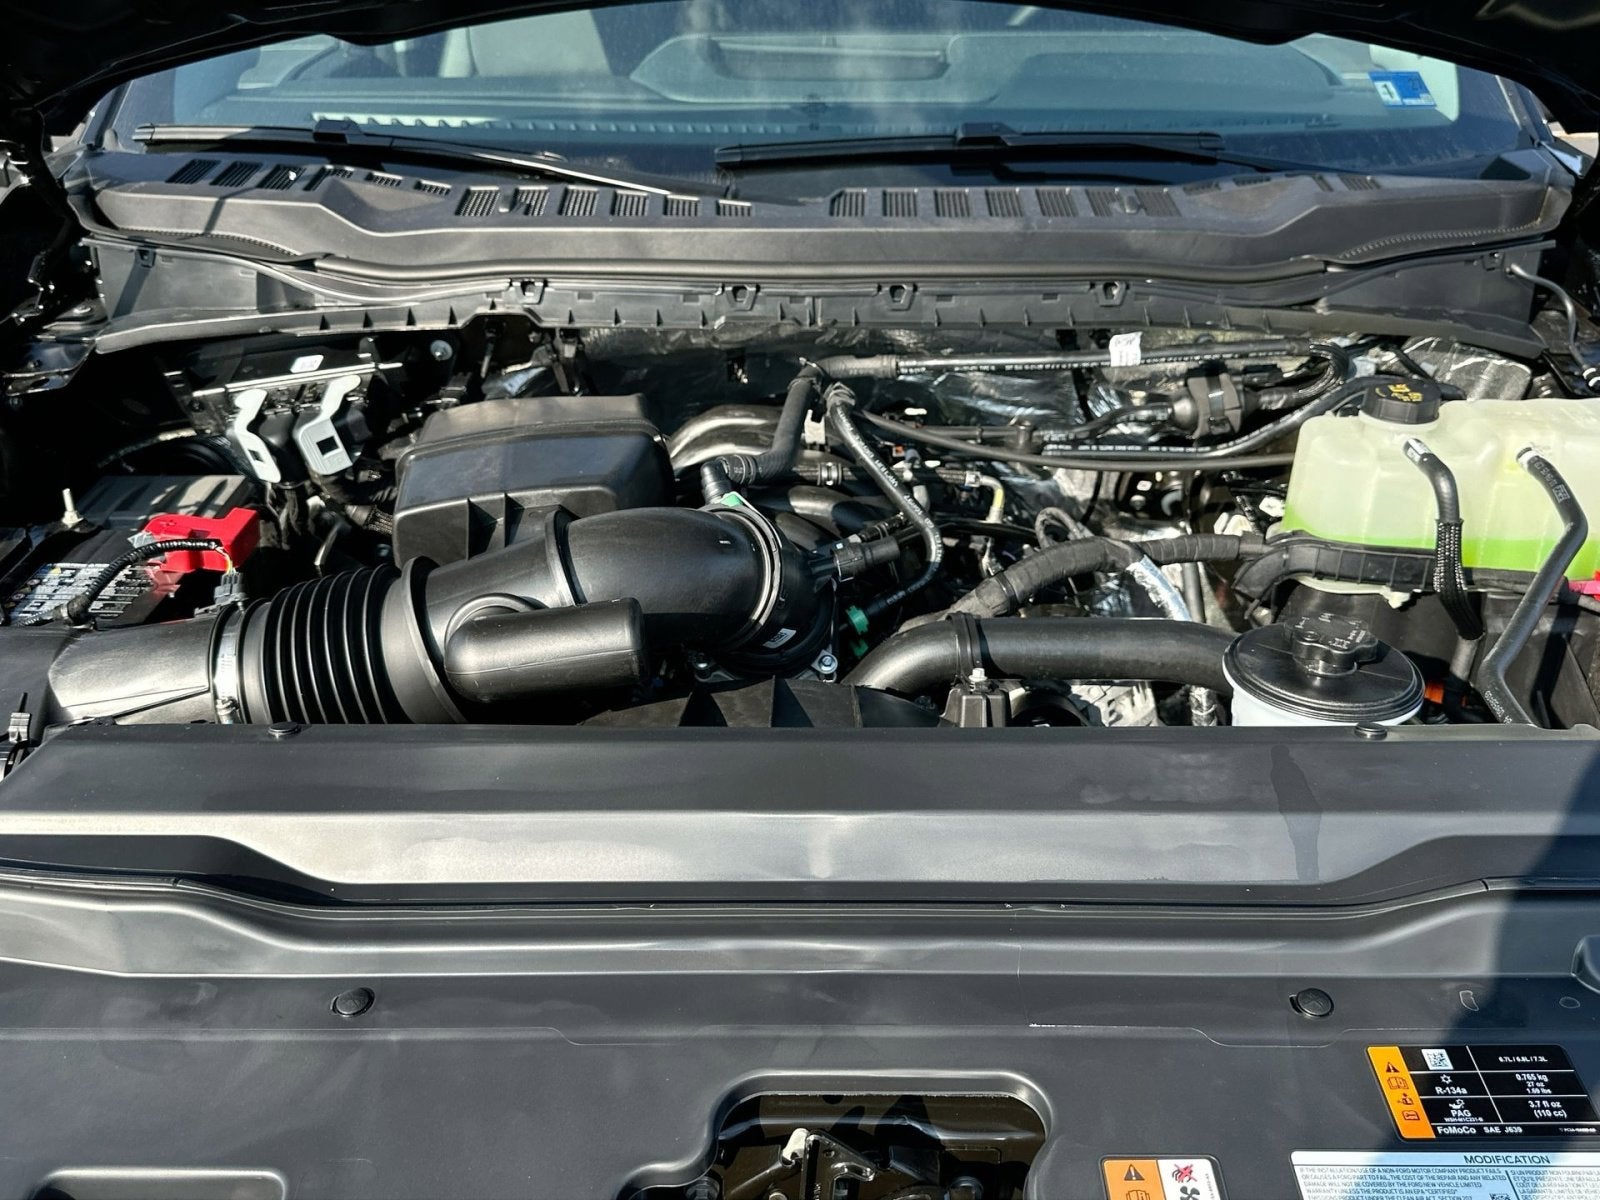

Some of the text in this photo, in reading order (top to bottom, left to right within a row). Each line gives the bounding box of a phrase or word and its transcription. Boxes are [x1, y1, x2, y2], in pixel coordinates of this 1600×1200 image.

[1515, 1073, 1549, 1082] 0.765 kg
[1435, 1086, 1468, 1095] R-134a
[1528, 1100, 1540, 1108] 3.7
[1542, 1100, 1550, 1108] fl
[1450, 1109, 1472, 1117] PAG
[1533, 1109, 1568, 1118] (110 cc)
[1436, 1126, 1477, 1134] FoMoCo
[1463, 1155, 1551, 1164] MODIFICATION
